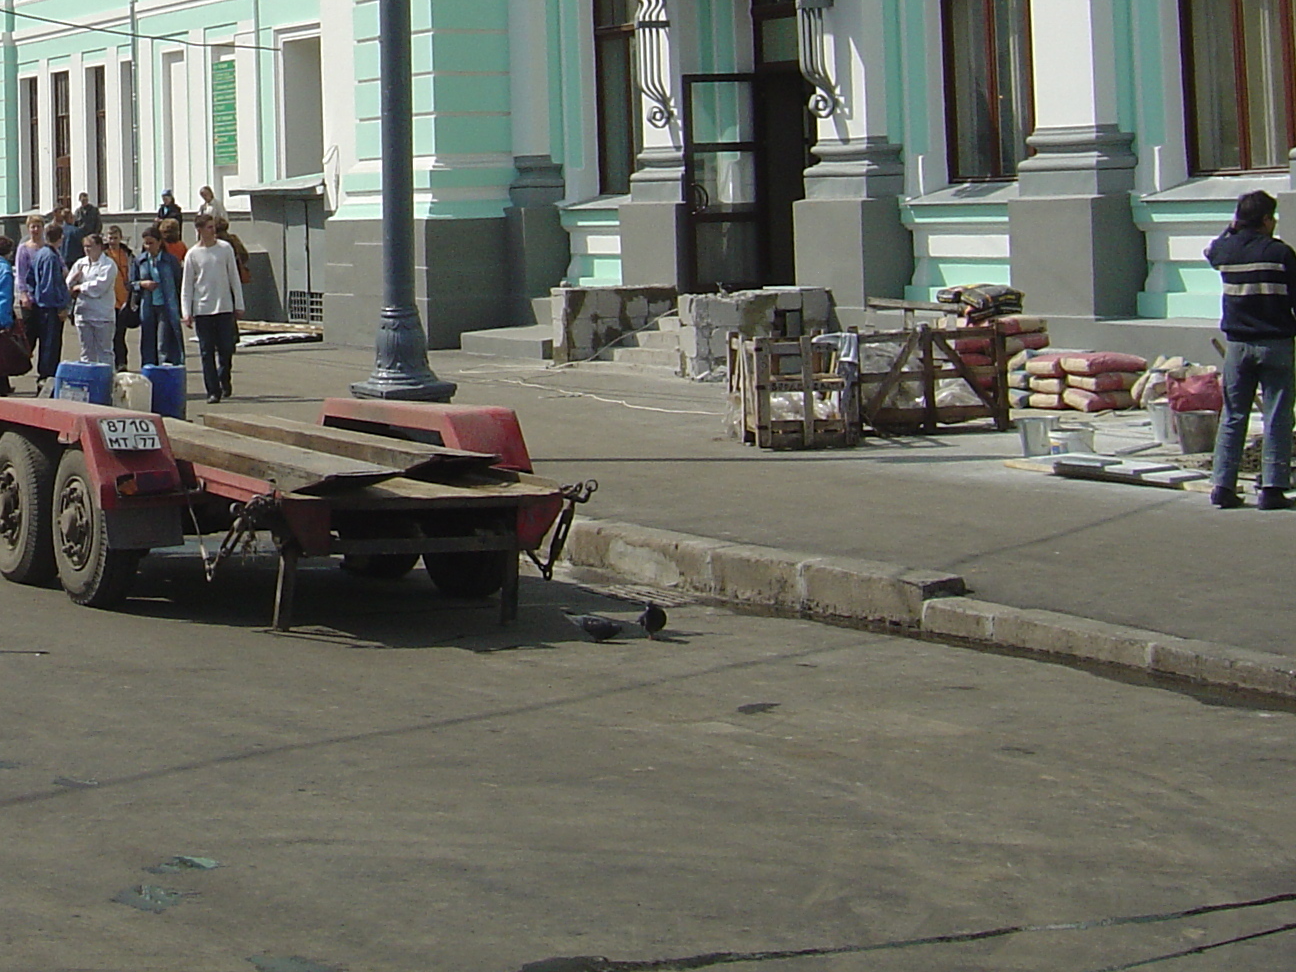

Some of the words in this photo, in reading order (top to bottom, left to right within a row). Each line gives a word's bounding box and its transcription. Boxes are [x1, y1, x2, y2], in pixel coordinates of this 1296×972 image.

[107, 420, 150, 433] 8710
[108, 437, 128, 448] МТ
[139, 437, 156, 448] 77
